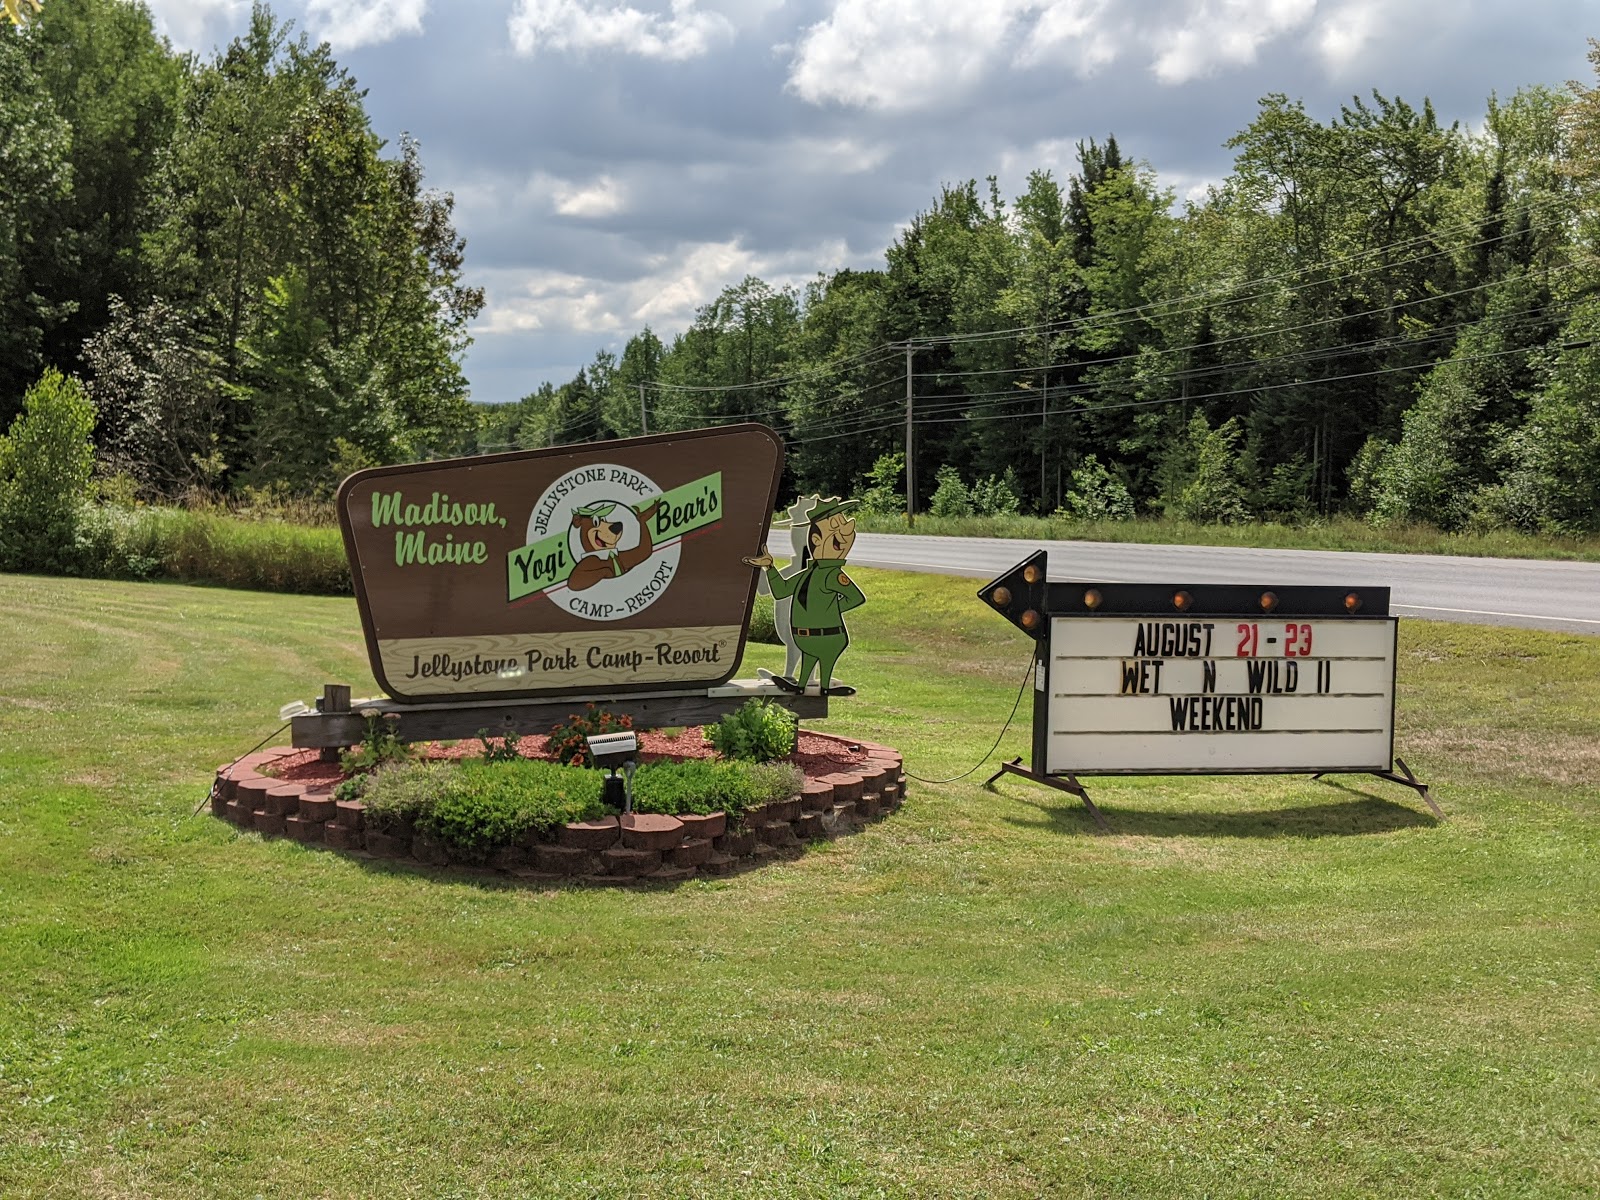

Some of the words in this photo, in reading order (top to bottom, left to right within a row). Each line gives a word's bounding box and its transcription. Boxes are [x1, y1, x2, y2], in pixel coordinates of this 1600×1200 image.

[371, 491, 507, 528] Madison,
[534, 468, 606, 535] JELLYSTONE
[395, 531, 488, 566] Maine
[514, 541, 566, 585] Yogi
[656, 486, 718, 535] Bear's
[1133, 623, 1215, 657] AUGUST
[1237, 624, 1258, 657] 21
[1284, 624, 1313, 657] 23
[405, 653, 519, 682] Jellystone
[524, 648, 580, 672] Park
[1121, 660, 1164, 694] WET
[1203, 660, 1216, 694] N
[1247, 660, 1298, 694] WILD
[1169, 697, 1263, 731] WEEKEND
